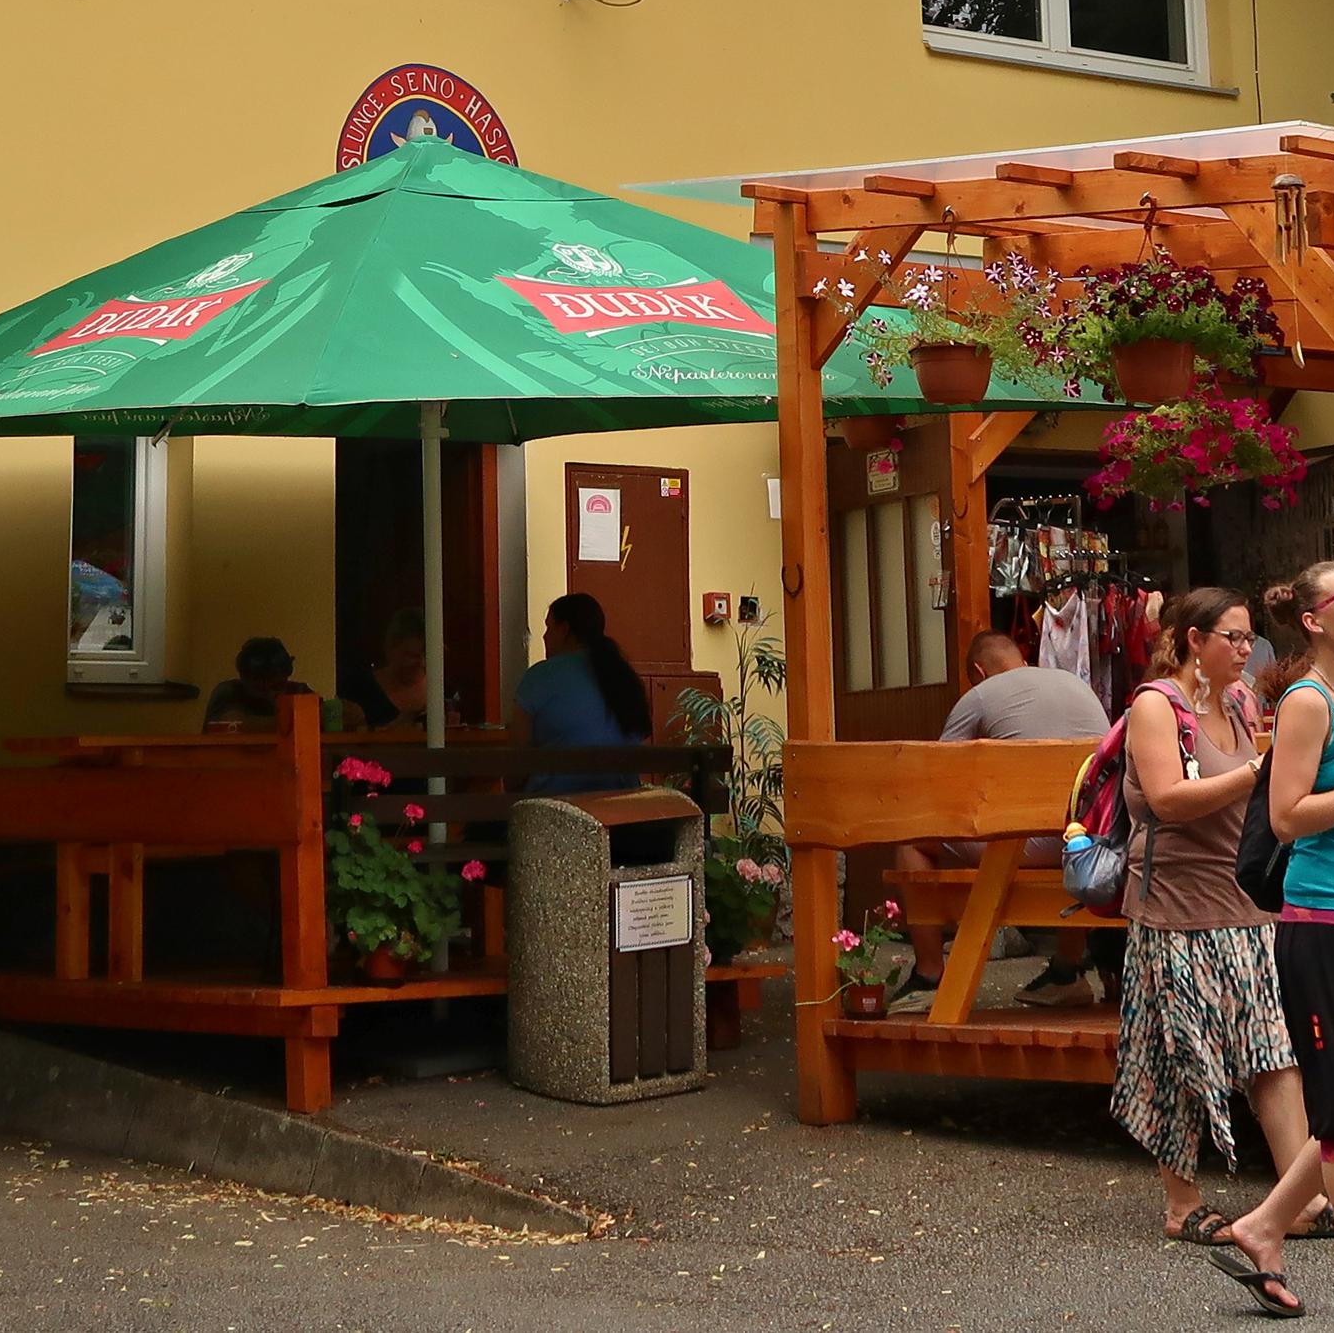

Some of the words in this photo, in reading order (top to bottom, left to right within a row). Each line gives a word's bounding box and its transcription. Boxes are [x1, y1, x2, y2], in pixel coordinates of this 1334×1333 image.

[341, 92, 384, 168] SLUNCE
[390, 71, 455, 99] SENO
[540, 289, 746, 322] DUDÁK
